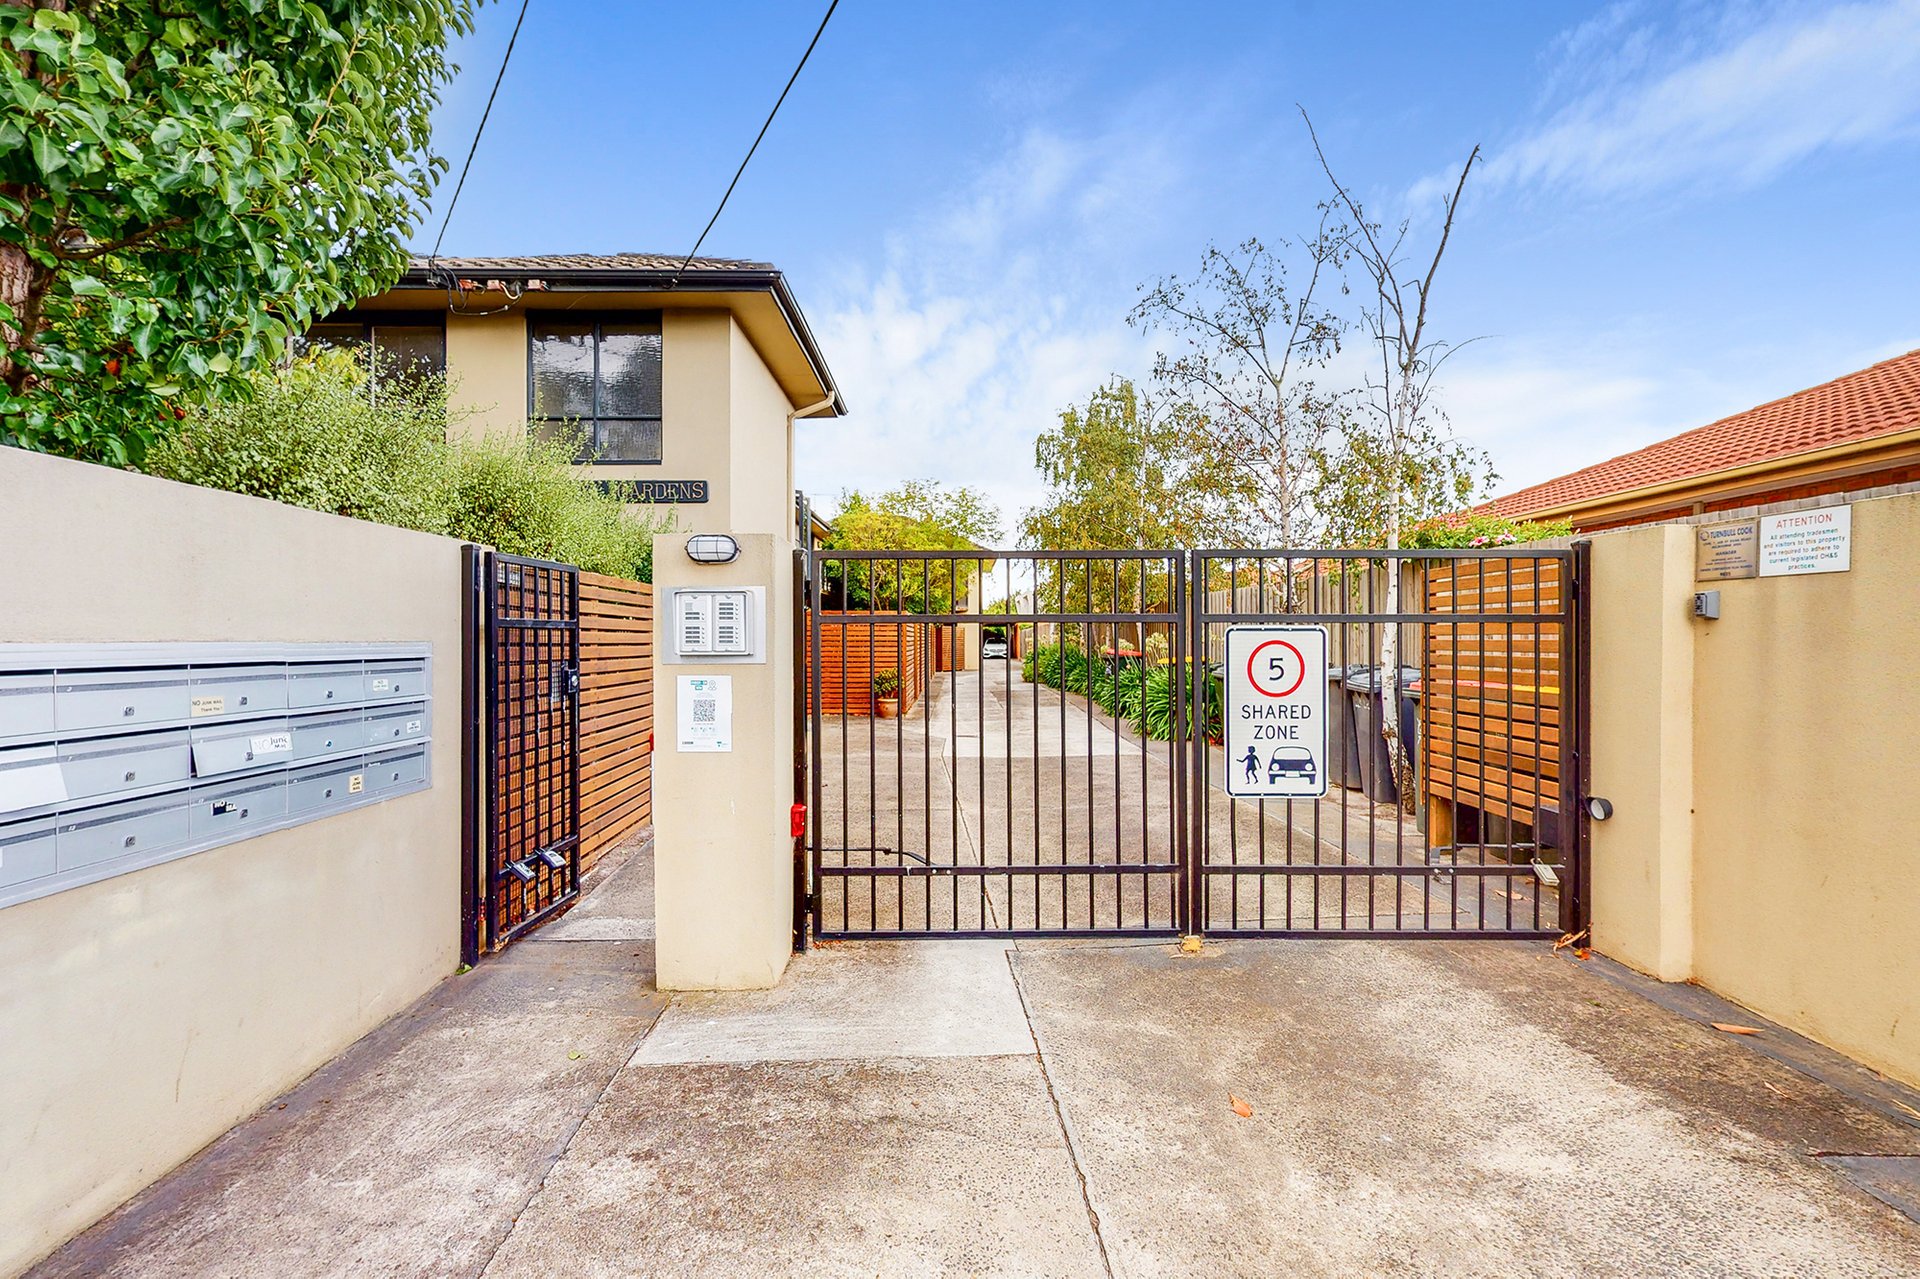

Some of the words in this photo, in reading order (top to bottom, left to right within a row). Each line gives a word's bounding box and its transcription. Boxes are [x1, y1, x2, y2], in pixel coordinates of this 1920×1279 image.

[1776, 513, 1833, 529] ATTENTION
[1737, 526, 1753, 536] COOK
[1779, 531, 1805, 540] attending
[1807, 528, 1838, 537] tradesmen
[1775, 540, 1796, 548] visitors
[1818, 535, 1846, 544] property
[1778, 548, 1801, 556] required
[1810, 545, 1831, 553] adhere
[1819, 552, 1839, 560] OH&S
[1269, 657, 1285, 681] 5
[1241, 704, 1311, 720] SHARED
[1253, 725, 1299, 740] ZONE
